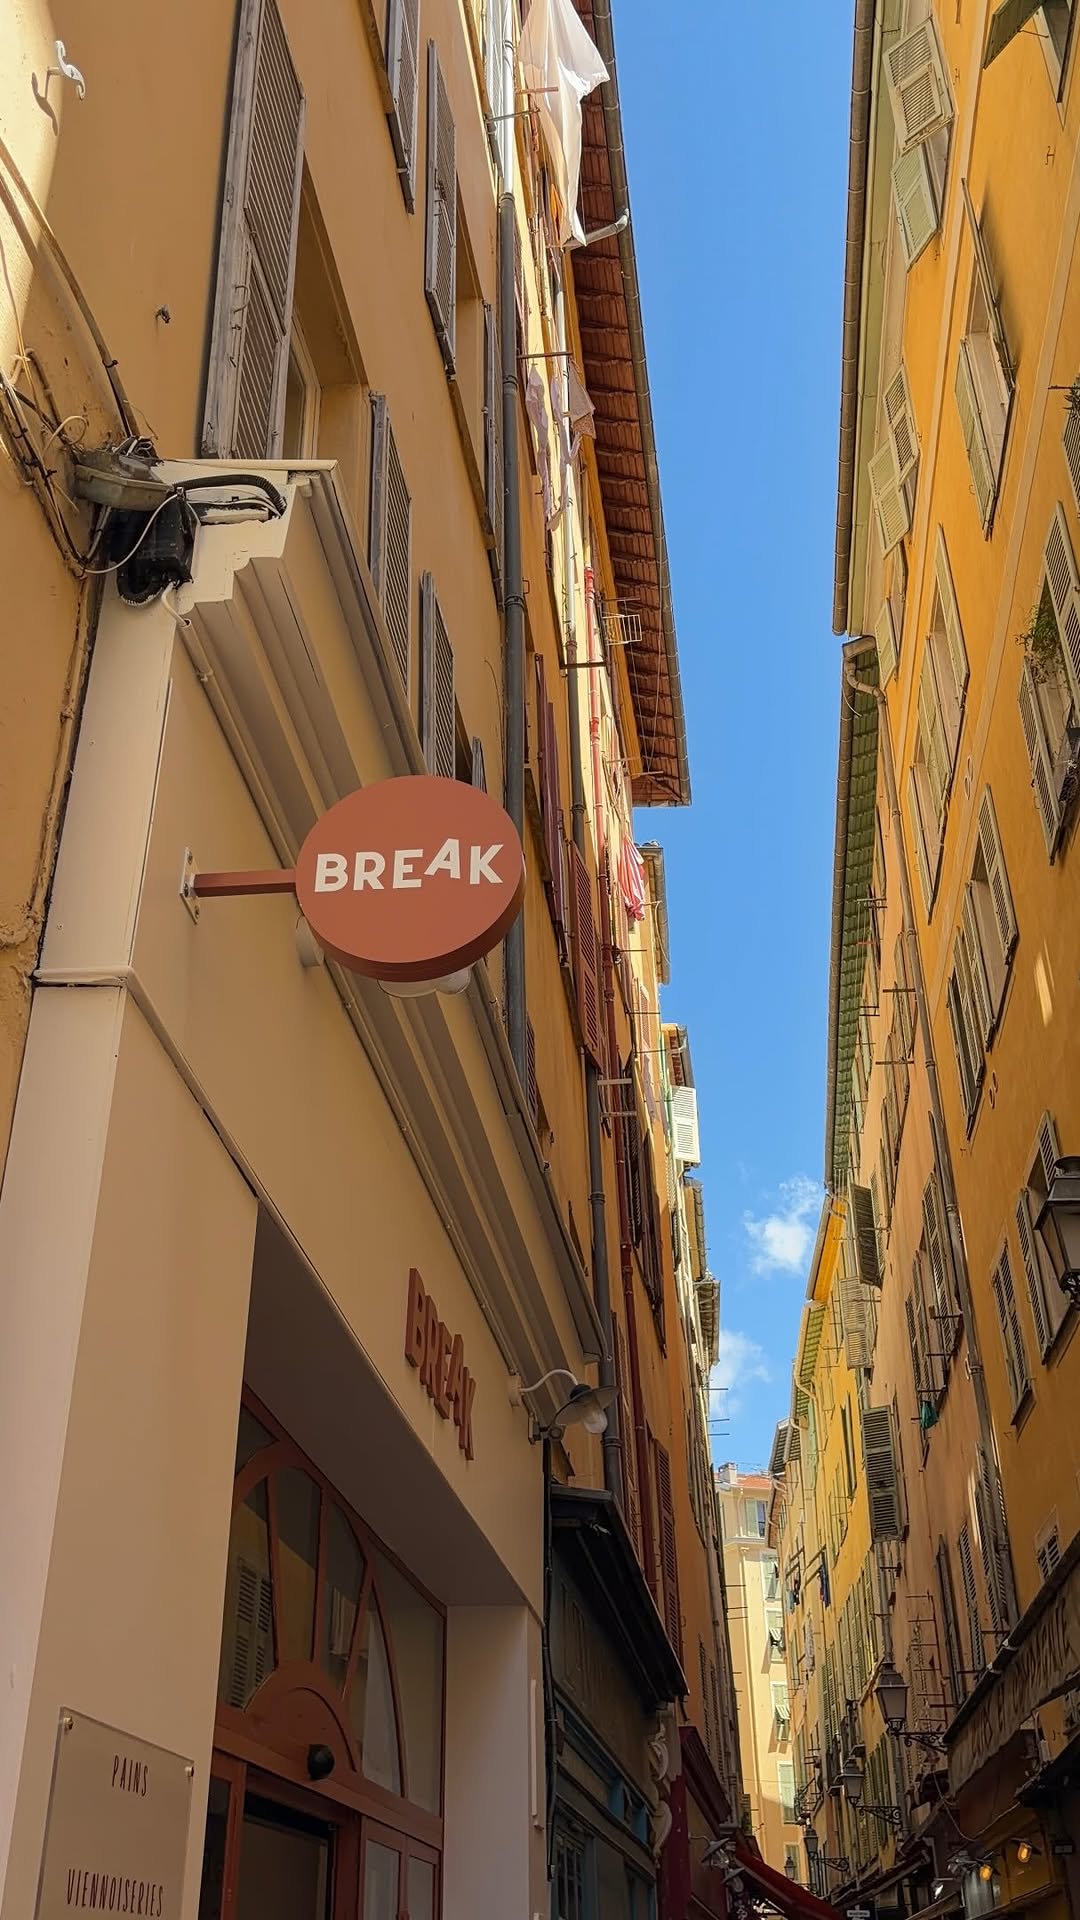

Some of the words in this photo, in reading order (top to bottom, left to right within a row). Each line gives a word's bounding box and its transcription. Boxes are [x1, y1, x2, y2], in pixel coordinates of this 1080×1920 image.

[314, 838, 504, 893] BREAK
[405, 1267, 477, 1461] BREAK
[111, 1754, 149, 1797] PAINS
[66, 1868, 164, 1918] VIENNOISERIES
